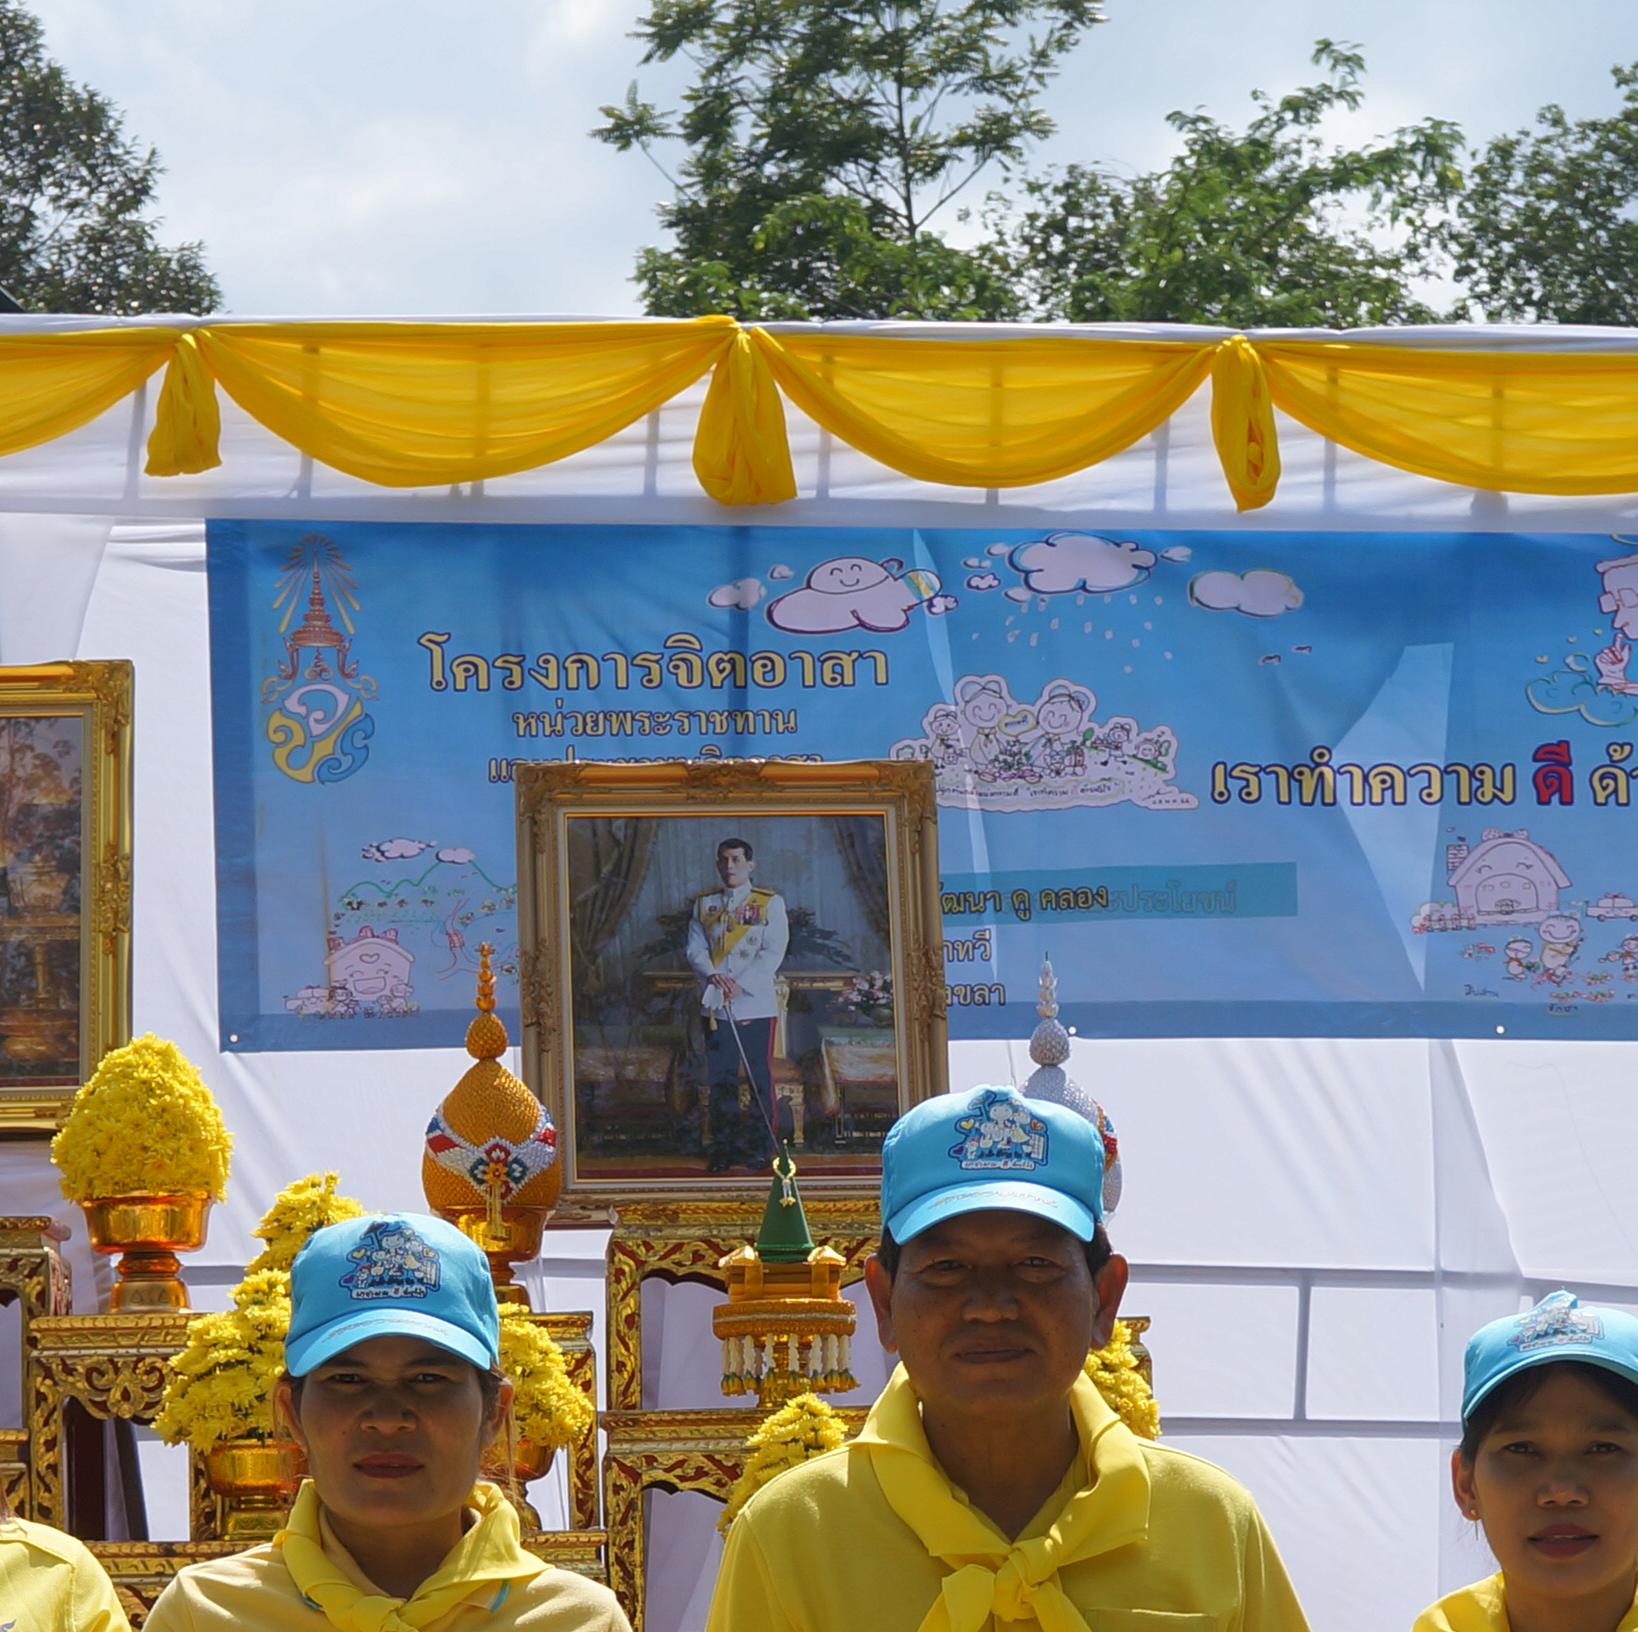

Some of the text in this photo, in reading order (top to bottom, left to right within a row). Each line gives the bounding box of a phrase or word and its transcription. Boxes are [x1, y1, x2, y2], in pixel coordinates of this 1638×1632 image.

[419, 633, 890, 692] โครงการจิตอาสา
[512, 697, 798, 738] หน่วยพระราชทาน
[1212, 746, 1515, 807] เราทำความ
[1532, 739, 1574, 806] ดี
[1011, 888, 1032, 920] คู
[1039, 884, 1109, 911] คลอง
[943, 928, 991, 962] าทวี
